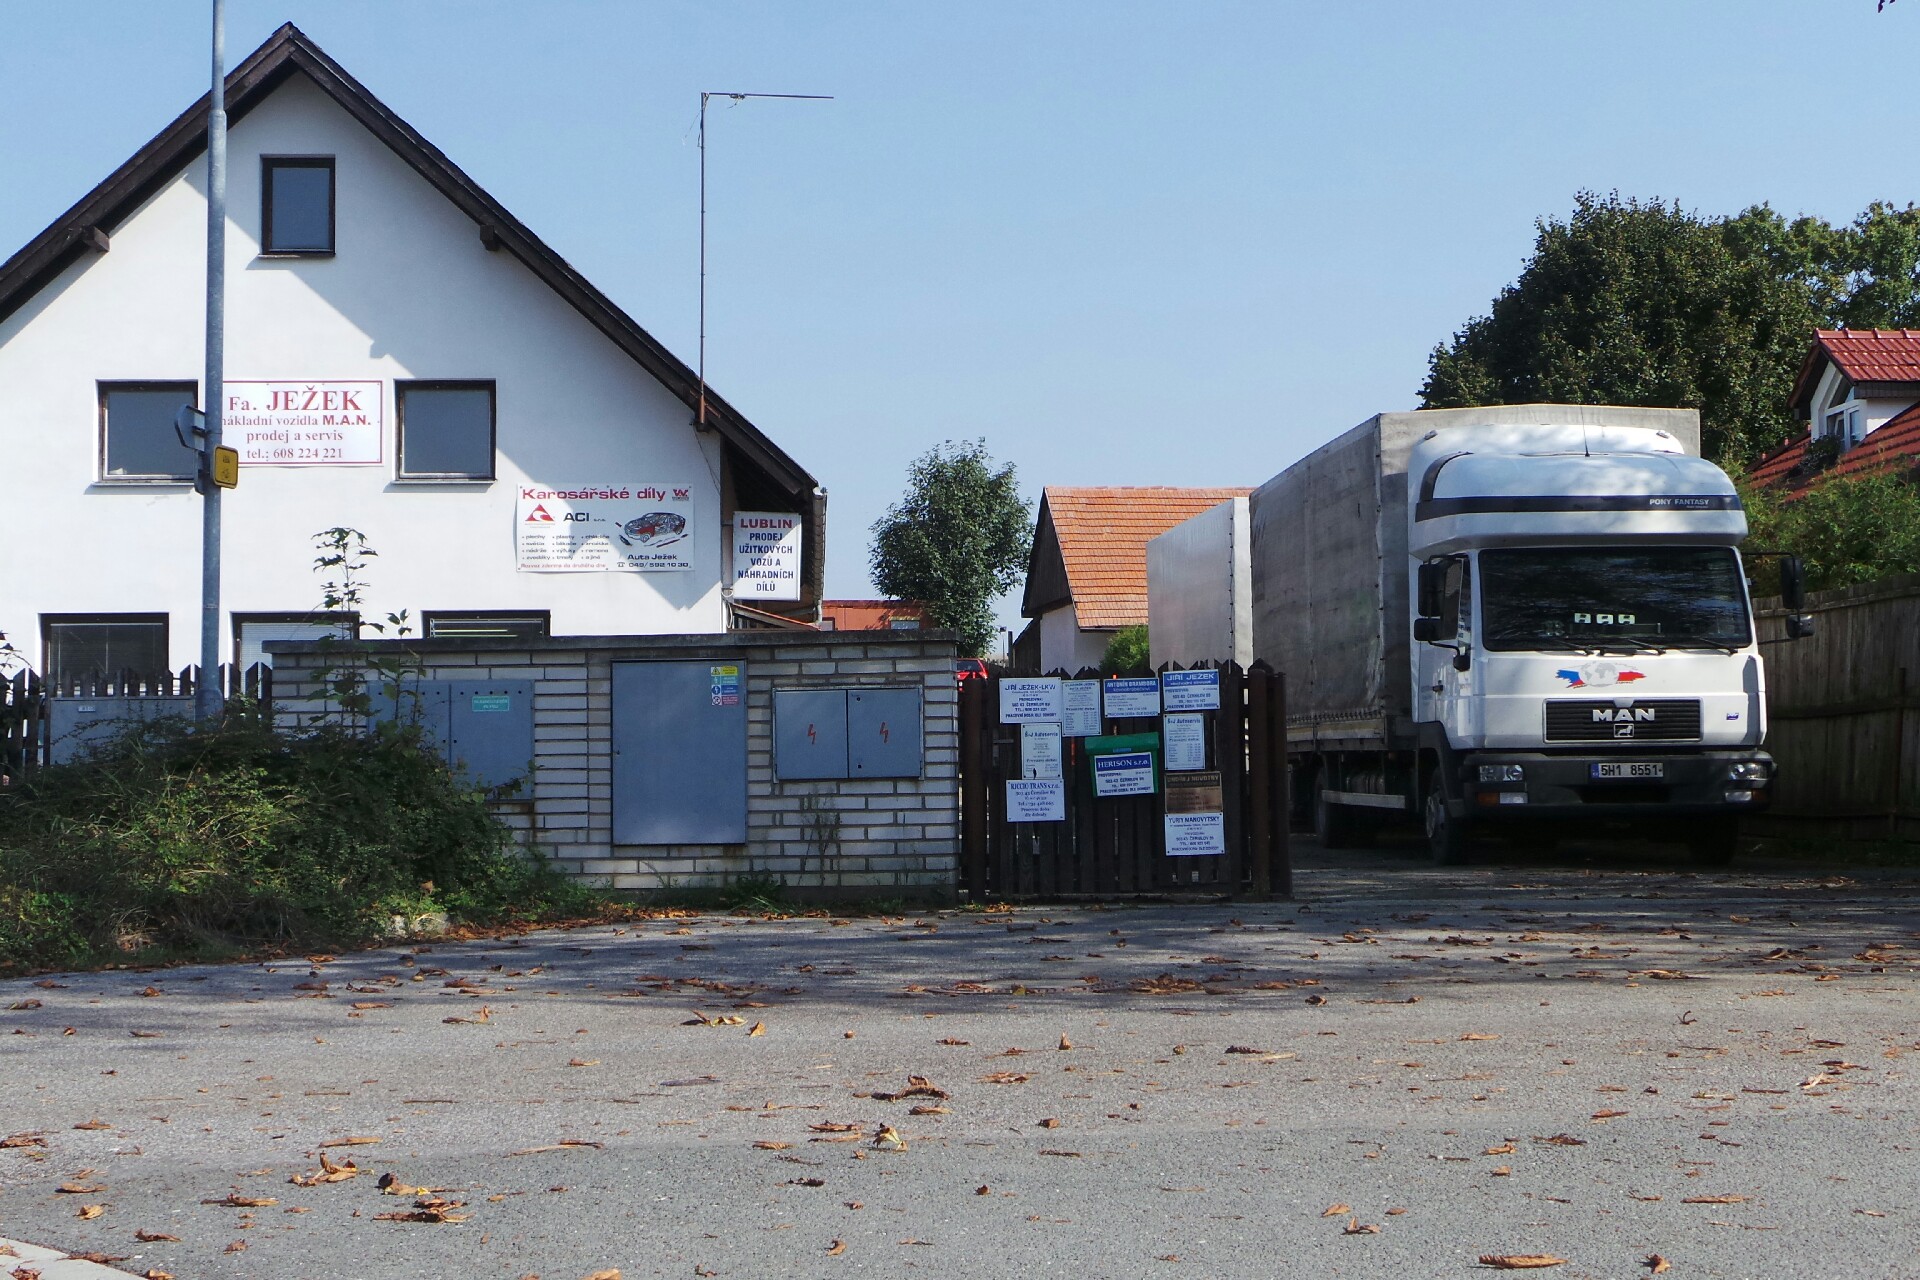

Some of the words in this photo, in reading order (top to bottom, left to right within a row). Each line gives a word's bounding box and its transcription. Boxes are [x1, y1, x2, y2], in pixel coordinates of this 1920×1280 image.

[229, 396, 257, 411] Fa.
[266, 385, 362, 411] JEŽEK
[276, 415, 318, 426] vozidla
[322, 415, 371, 426] M.A.N.
[246, 429, 289, 443] prodej
[293, 433, 301, 441] a
[305, 429, 344, 441] servis
[246, 448, 269, 459] tel.:
[273, 448, 294, 459] 608
[298, 448, 319, 459] 224
[323, 448, 343, 459] 221
[522, 486, 630, 500] Karosářské
[637, 487, 666, 502] díly
[563, 512, 590, 522] ACI
[740, 518, 792, 529] LUBLIN
[749, 532, 783, 541] PRODEJ
[738, 543, 793, 554] UŽITKOVÝCH
[750, 555, 772, 567] VOZŮ
[775, 558, 781, 567] A
[737, 568, 794, 579] NÁHRADNÍCH
[756, 580, 775, 592] DÍLŮ
[1186, 672, 1215, 681] JEŽEK
[1592, 708, 1655, 722] MAN
[1097, 759, 1132, 769] HERISON
[1600, 764, 1622, 776] 5H1
[1630, 764, 1658, 776] 8551
